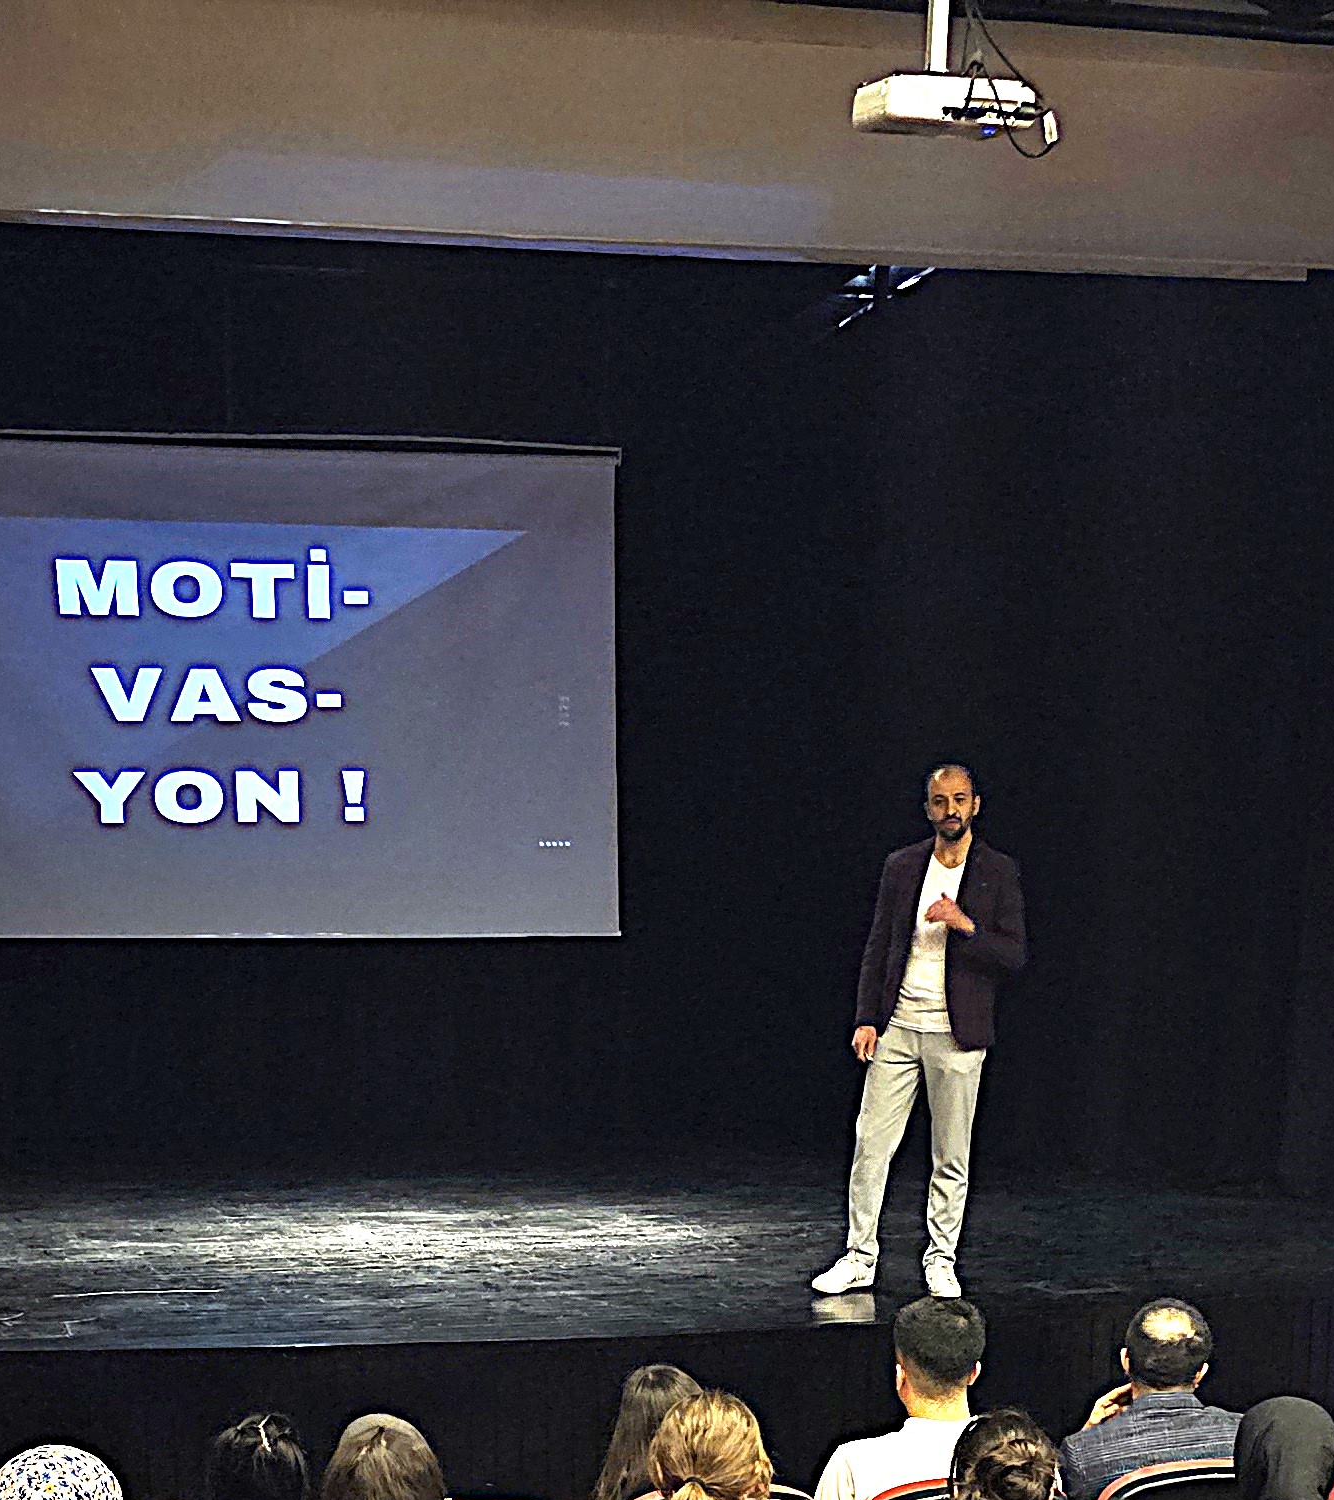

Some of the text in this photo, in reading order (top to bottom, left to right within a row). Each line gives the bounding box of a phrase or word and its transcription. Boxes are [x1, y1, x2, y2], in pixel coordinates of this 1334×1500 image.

[55, 548, 369, 620] MOTİ-
[90, 667, 342, 723] VAS-
[72, 770, 365, 824] YON !
